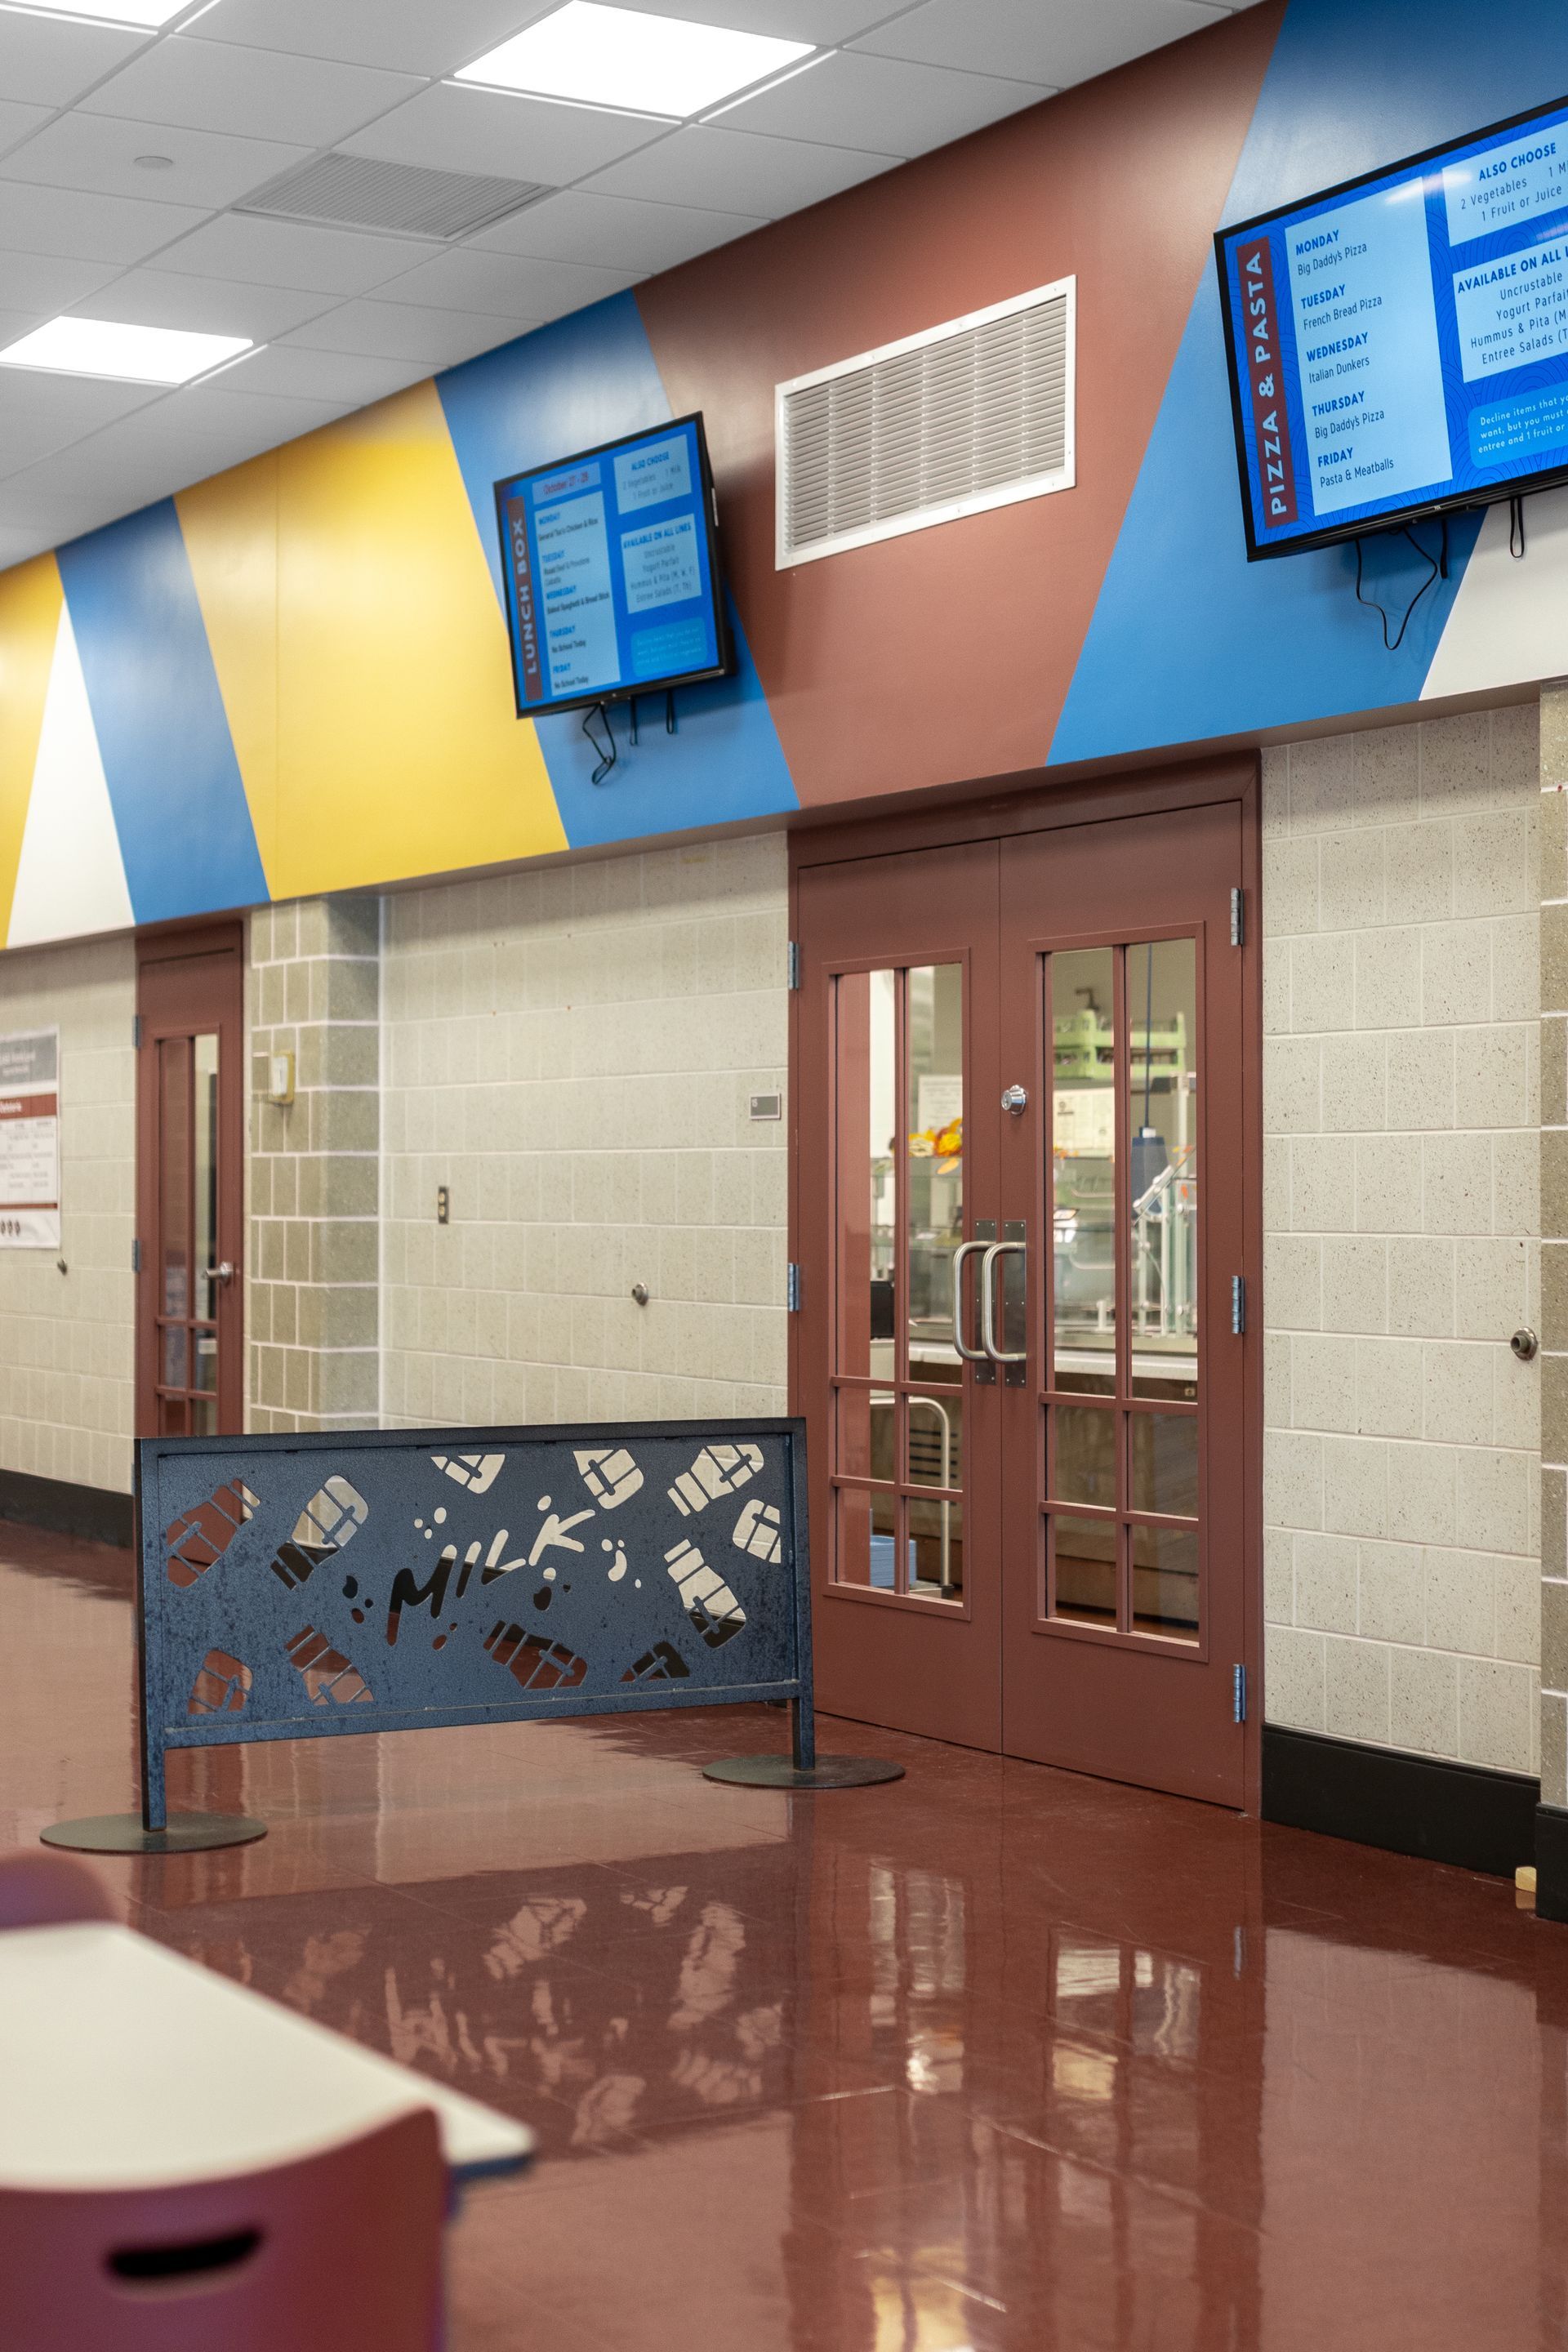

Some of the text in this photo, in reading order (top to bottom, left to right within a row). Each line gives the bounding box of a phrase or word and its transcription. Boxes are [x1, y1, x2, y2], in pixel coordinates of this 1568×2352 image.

[1479, 143, 1557, 180] ALSO CHOOSE
[1461, 198, 1466, 210] 2
[1471, 178, 1527, 206] Vegetables
[1549, 167, 1552, 177] 1
[1482, 185, 1561, 221] 1 Fruit or Juice
[1296, 229, 1339, 256] MONDAY
[1298, 243, 1367, 275] Big Daddy's Pizza
[1458, 264, 1517, 293] AVAILABLE
[1521, 256, 1537, 272] ON
[1542, 249, 1561, 265] ALL
[1301, 284, 1346, 310] TUESDAY
[1500, 272, 1562, 301] Uncrustable
[1303, 296, 1383, 330] French Bread Pizza
[1496, 301, 1530, 320] Yogurt
[1307, 332, 1368, 362] WEDNESDAY
[1471, 327, 1513, 349] Hummus
[1518, 323, 1524, 334] &
[1530, 316, 1549, 330] Pita
[1482, 347, 1515, 364] Entree
[1520, 334, 1553, 353] Salads
[1246, 252, 1287, 515] PIZZA & PASTA
[1309, 357, 1370, 383] Italian Dunkers
[1312, 390, 1365, 416] THURSDAY
[1481, 412, 1511, 425] Decline
[1513, 404, 1536, 416] items
[1539, 397, 1557, 409] that
[1315, 410, 1384, 439] Big Daddy's Pizza
[1478, 423, 1565, 453] entree and 1 fruit or
[1481, 409, 1563, 439] want, but you must
[631, 451, 669, 470] ALSO CHOOSE
[1318, 448, 1353, 468] FRIDAY
[1321, 458, 1394, 488] Pasta & Meatballs
[539, 512, 560, 525] MONDAY
[623, 523, 692, 549] AVAILABLE ON ALL LINES
[542, 550, 565, 563] TUESDAY
[512, 518, 537, 675] LUNCH BOX
[546, 584, 577, 600] WEDNESDAY
[550, 625, 576, 638] THURSDAY
[553, 662, 571, 674] FRIDAY
[386, 1509, 596, 1646] MILK
